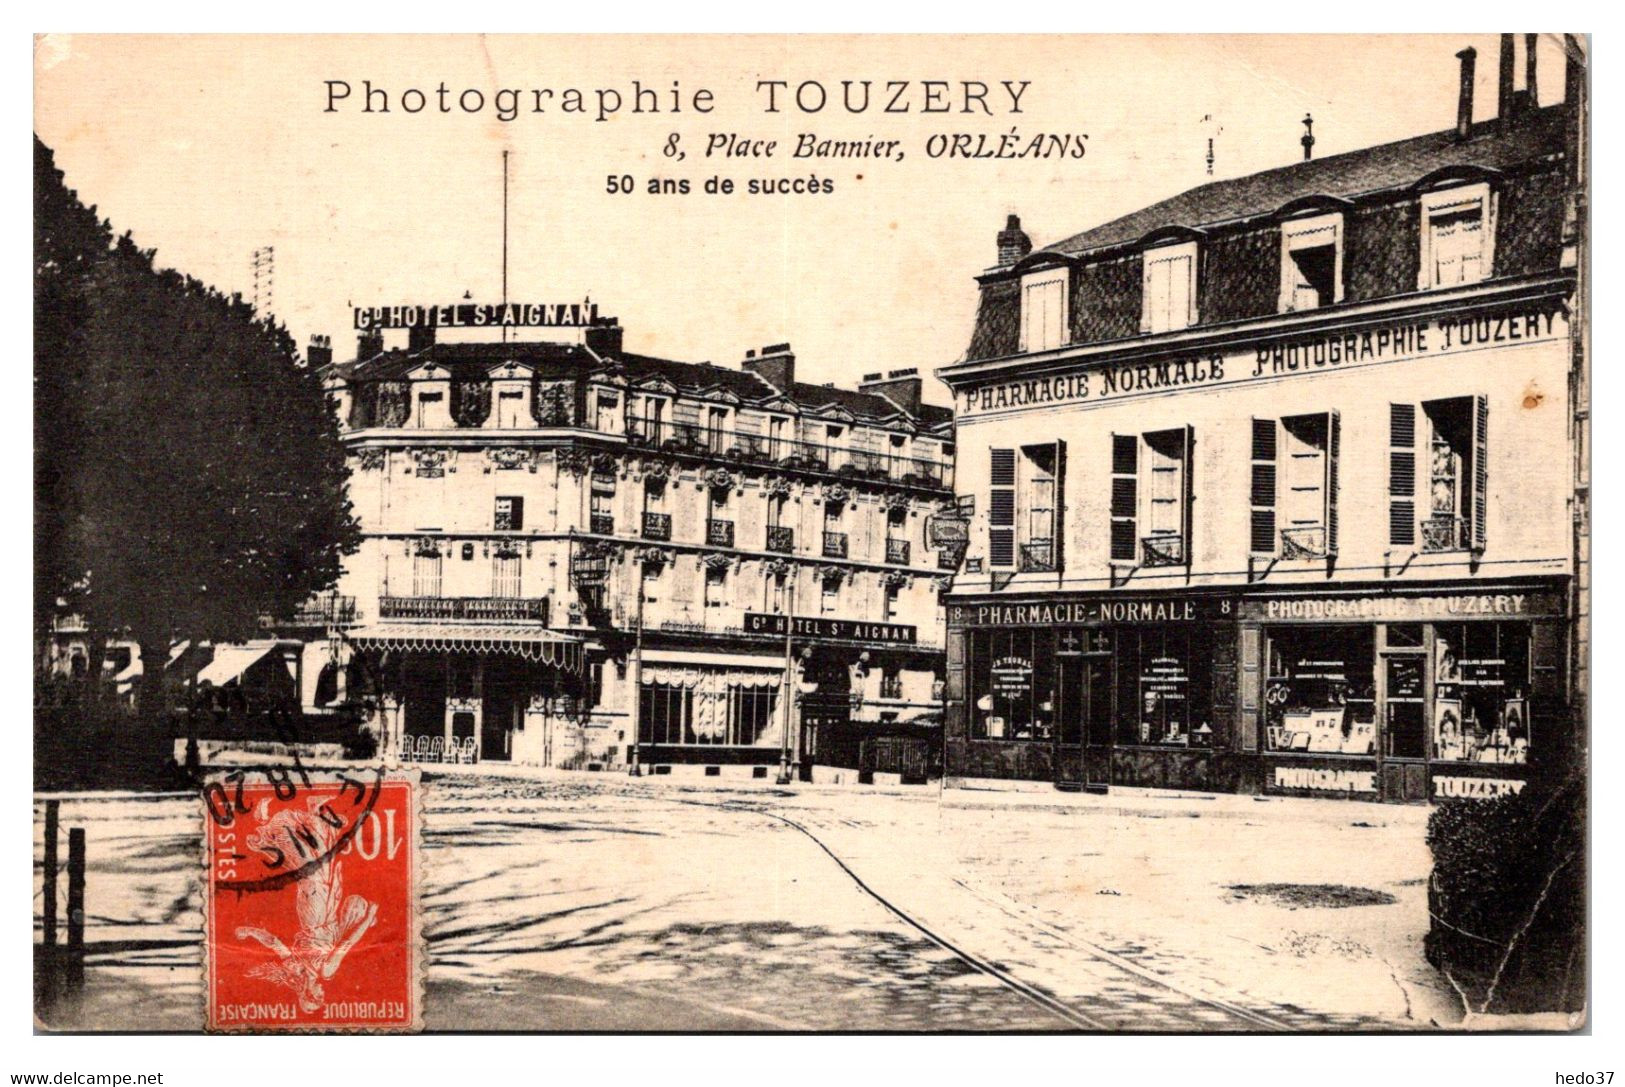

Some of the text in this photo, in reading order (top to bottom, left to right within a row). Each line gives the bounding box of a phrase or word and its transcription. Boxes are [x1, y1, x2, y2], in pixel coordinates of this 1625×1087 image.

[324, 80, 1032, 122] Photographie TOUZERY
[663, 126, 1089, 162] 8, Place Bannier, ORLÉANS
[606, 174, 834, 195] 50 ans de succès
[389, 305, 466, 327] HOTEL
[502, 303, 592, 326] AIGNAN
[1252, 312, 1558, 377] PHOTOGRAPHIE TOUZERY
[963, 354, 1225, 413] PHARMACIE NORMALE
[953, 606, 963, 621] 8
[1220, 600, 1232, 615] 8
[854, 626, 910, 642] AIGNAN
